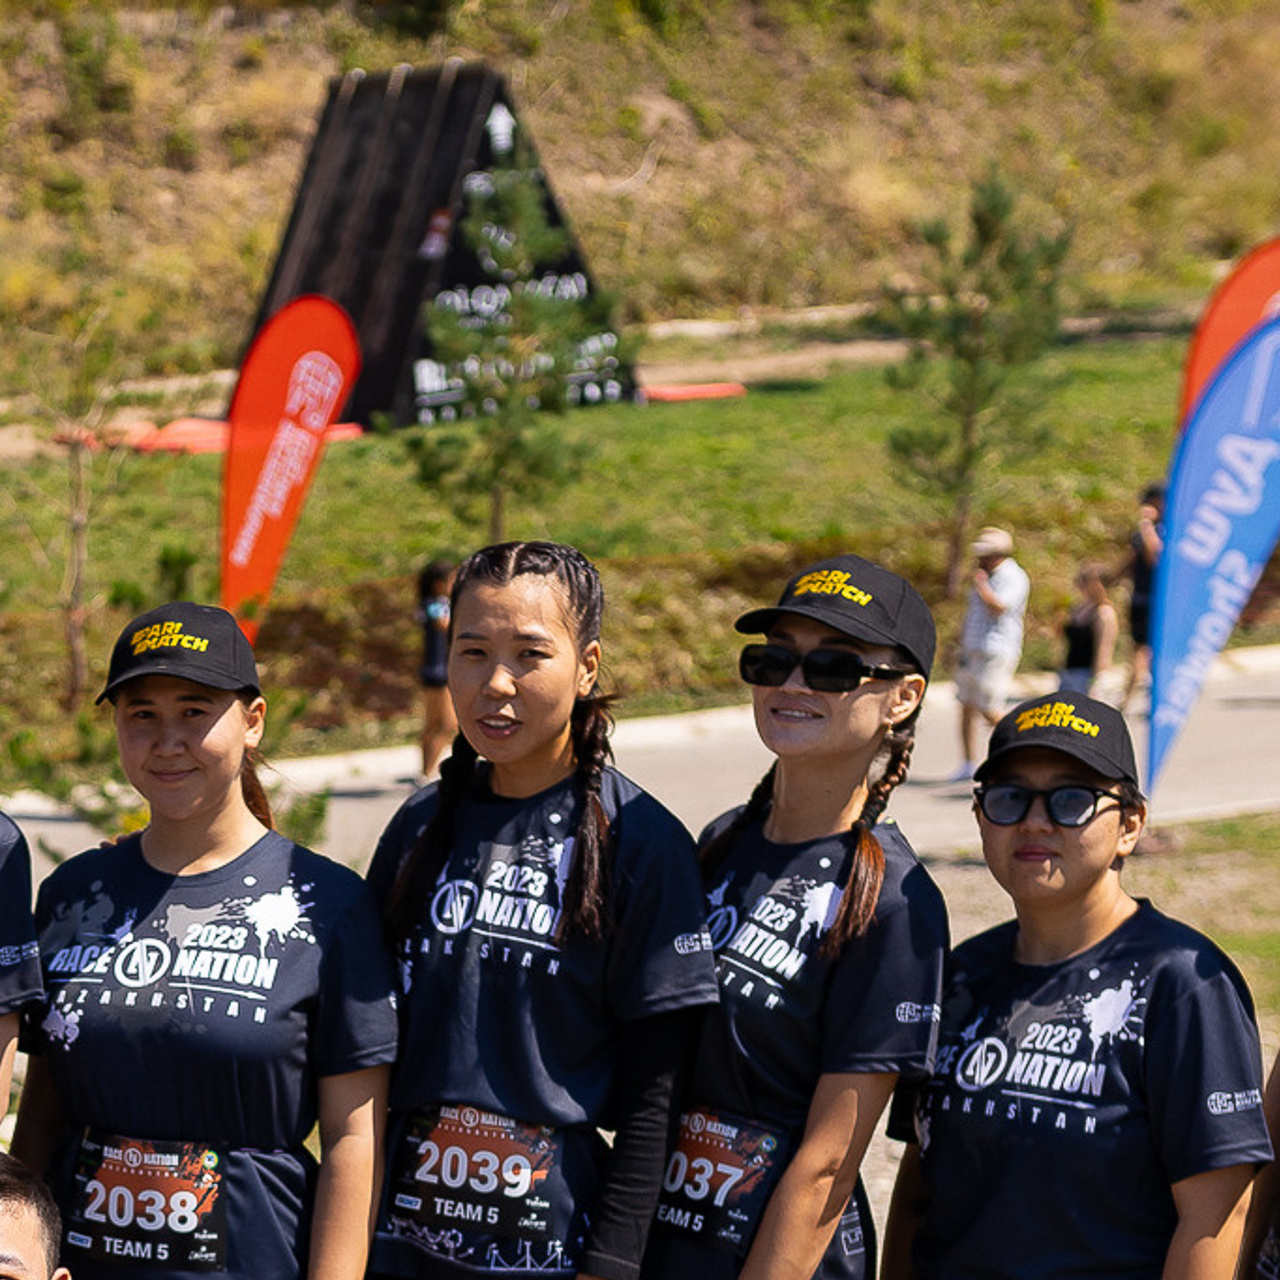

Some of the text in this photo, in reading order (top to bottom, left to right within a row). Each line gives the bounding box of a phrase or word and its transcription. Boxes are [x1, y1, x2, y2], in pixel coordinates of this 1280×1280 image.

[130, 621, 183, 646] PARI
[133, 634, 209, 656] MATCH
[487, 860, 549, 898] 2023
[184, 923, 249, 951] 2023
[48, 944, 115, 975] RACE
[172, 949, 278, 990] NATION
[1021, 1021, 1082, 1054] 2023
[1005, 1051, 1107, 1098] NATION
[143, 1153, 179, 1166] NATION
[415, 1140, 532, 1198] 2039
[663, 1151, 744, 1207] 037
[83, 1179, 199, 1233] 2038
[433, 1197, 483, 1222] TEAM
[487, 1207, 500, 1224] 5
[657, 1203, 691, 1229] EAM
[691, 1214, 704, 1232] 5
[103, 1236, 152, 1260] TEAM
[156, 1244, 169, 1260] 5
